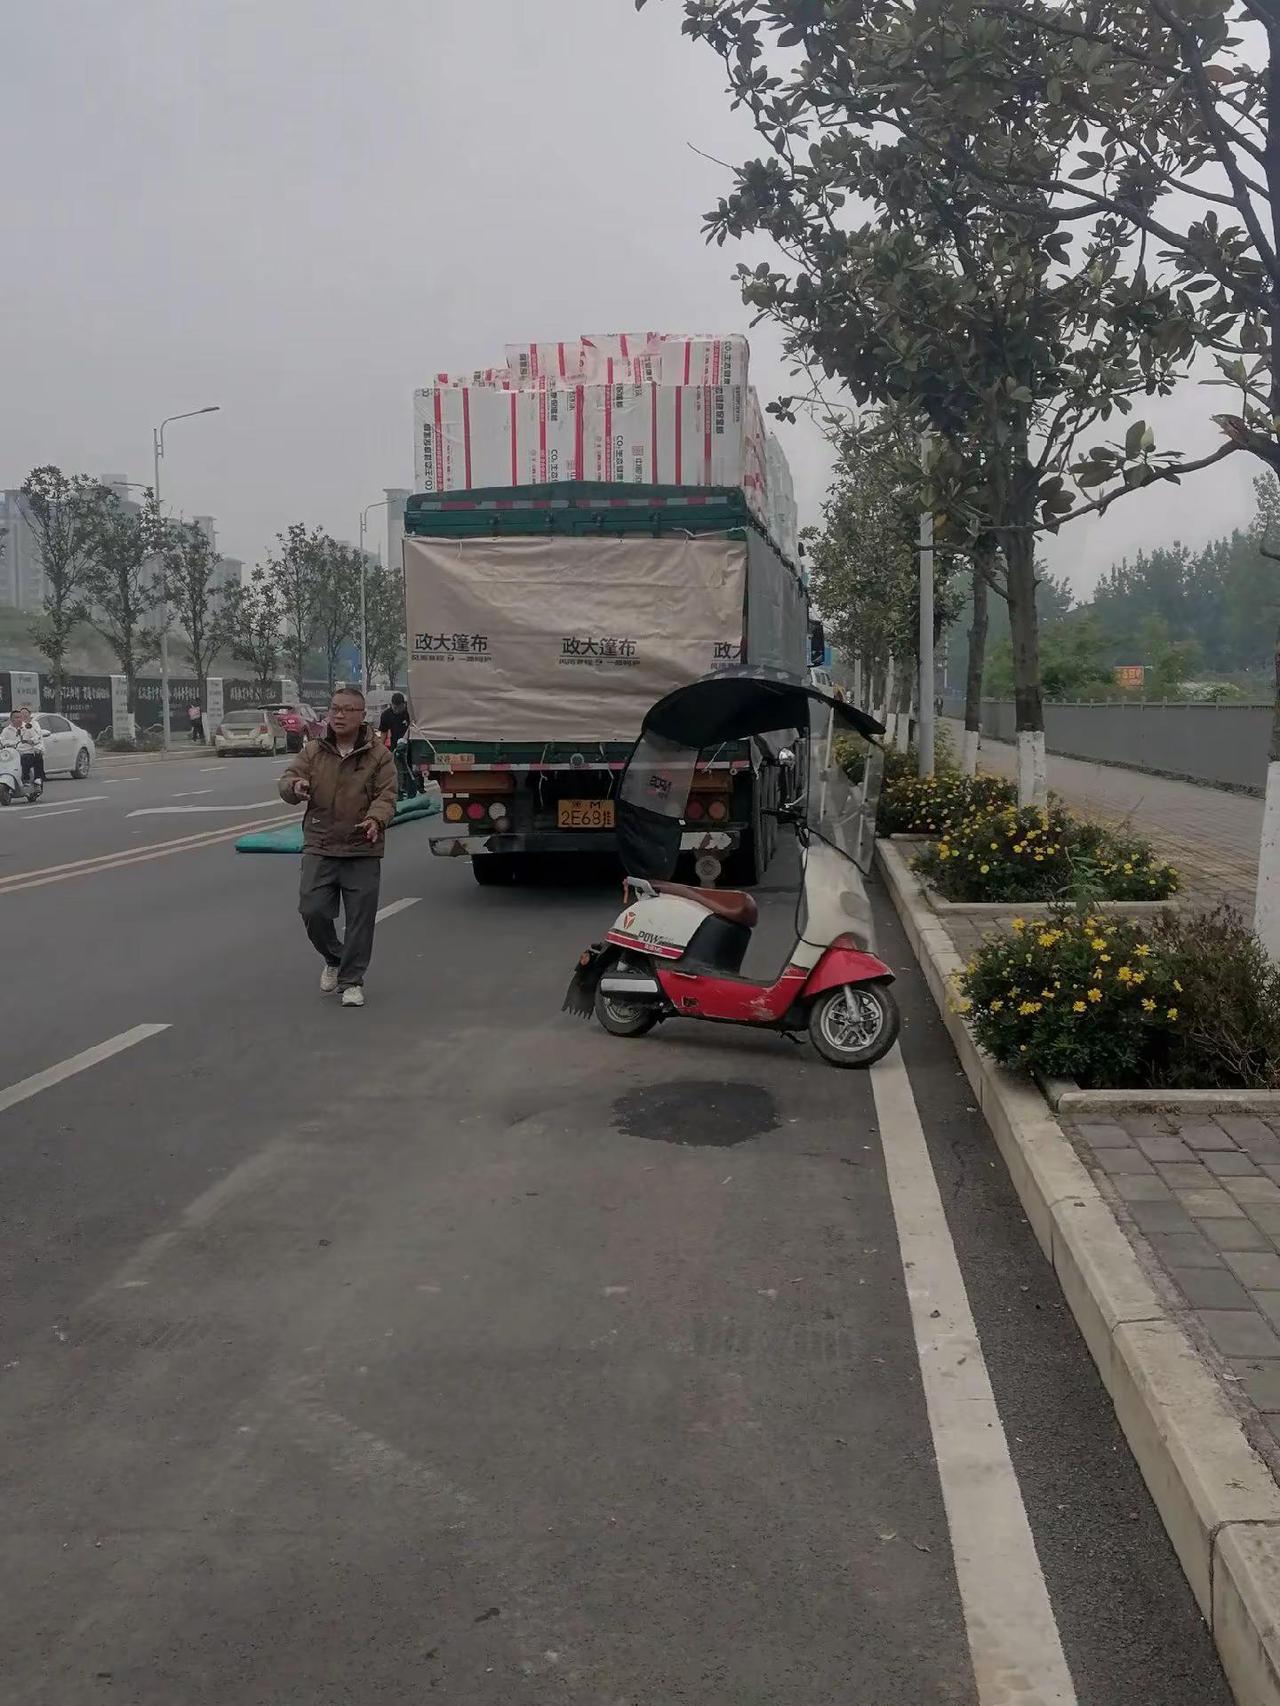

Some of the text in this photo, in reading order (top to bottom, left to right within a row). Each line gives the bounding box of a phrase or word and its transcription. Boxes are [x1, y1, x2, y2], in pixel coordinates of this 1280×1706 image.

[415, 633, 488, 652] 政大篷布
[562, 636, 637, 656] 政大篷布
